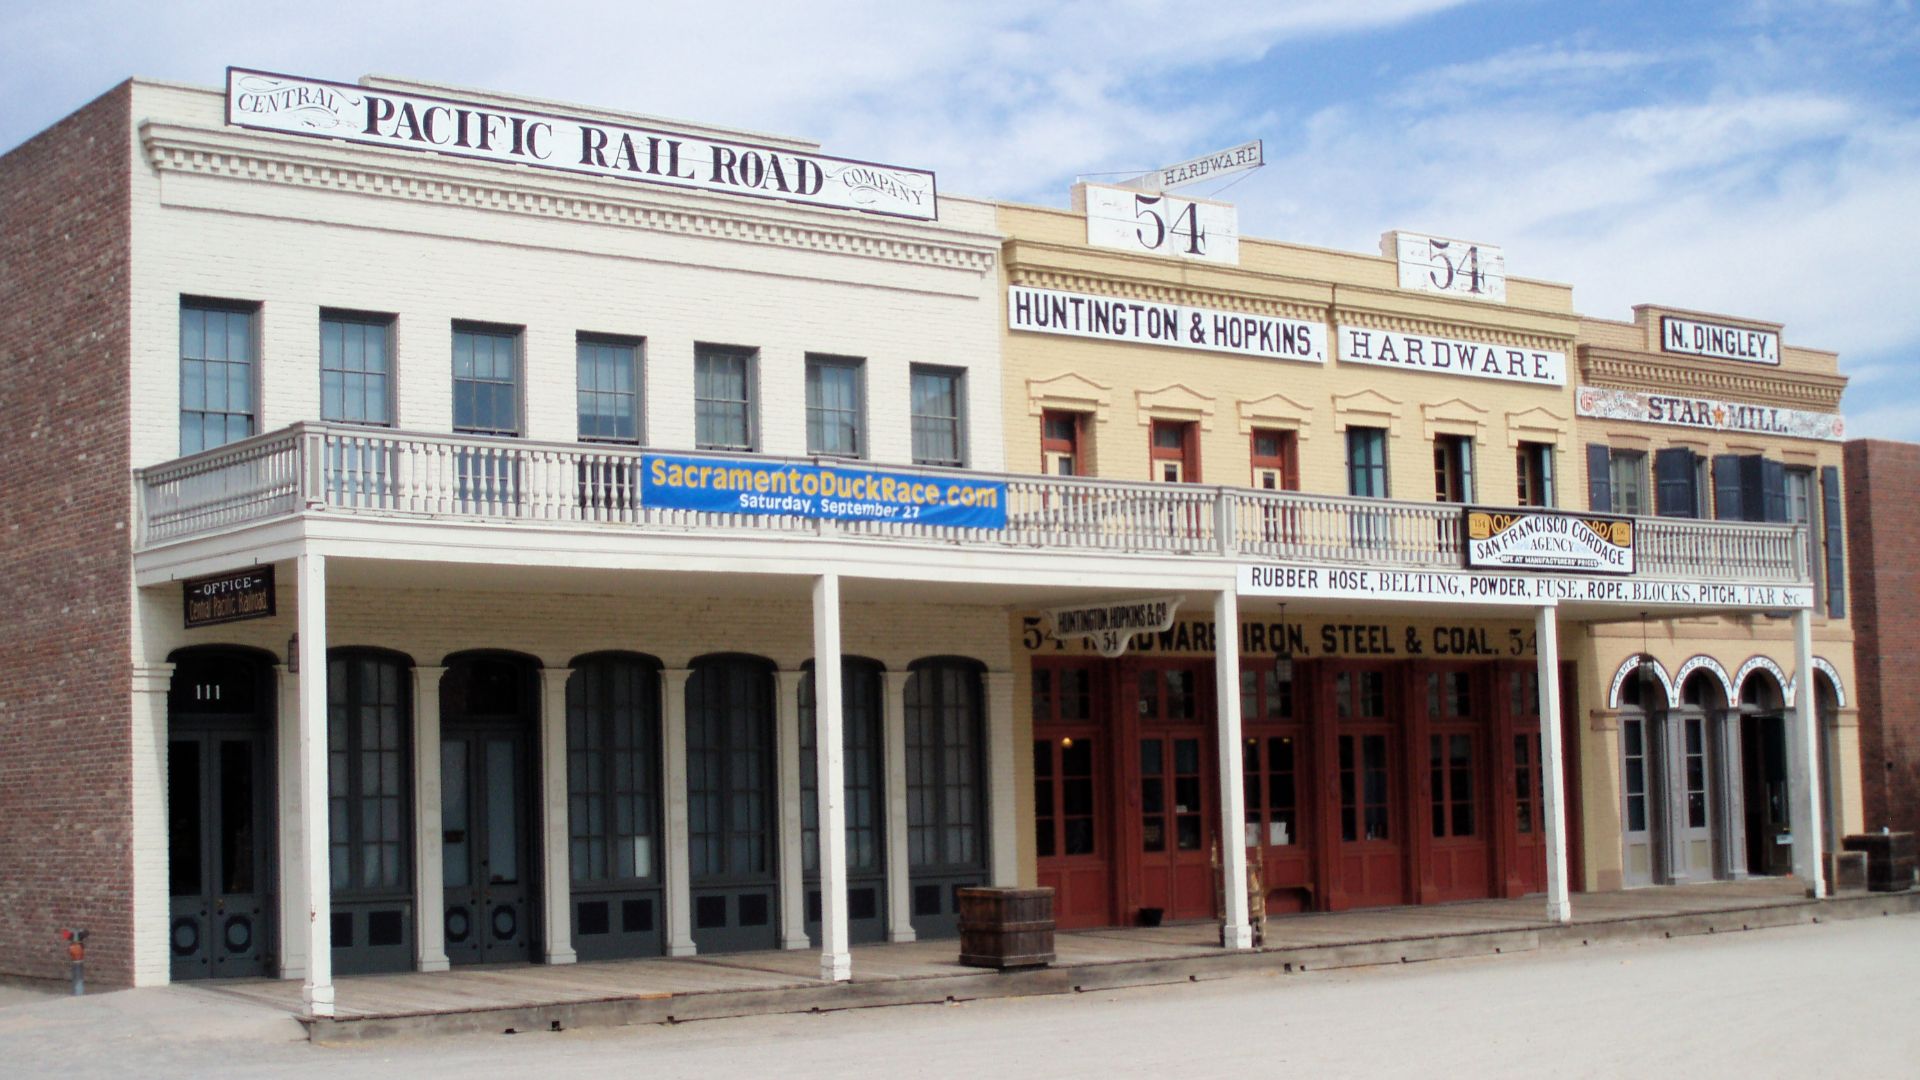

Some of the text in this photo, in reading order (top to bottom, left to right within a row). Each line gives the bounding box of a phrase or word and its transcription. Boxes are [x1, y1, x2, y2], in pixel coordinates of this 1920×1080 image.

[238, 87, 926, 206] CENTRAL PACIFIC RAIL ROAD COMPANY
[1164, 146, 1257, 185] HARDWARE
[1135, 193, 1205, 255] 54
[1429, 238, 1485, 294] 54
[1016, 291, 1178, 341] HUNTINGTON
[1190, 312, 1206, 344] &
[1671, 322, 1689, 348] N.
[1648, 396, 1713, 426] STAR
[651, 459, 997, 508] SacramentoDuckRace.com
[739, 493, 919, 520] Saturday, September 27
[1477, 516, 1625, 565] SAN FRANCISCO CORDAGE
[1530, 537, 1574, 552] AGENCY
[203, 577, 251, 595] OFFICE
[1252, 567, 1318, 589] RUBBER
[1329, 571, 1374, 594] HOSE,
[1379, 573, 1465, 596] BELTING,
[1470, 577, 1531, 598] POWDER,
[1536, 579, 1583, 600] FUSE,
[1588, 582, 1628, 601] ROPE,
[1633, 583, 1696, 603] BLOCKS,
[1744, 587, 1775, 605] TAR
[1104, 631, 1117, 651] 54
[1321, 624, 1395, 653] STEEL
[1405, 626, 1422, 652] &
[196, 684, 220, 700] 111
